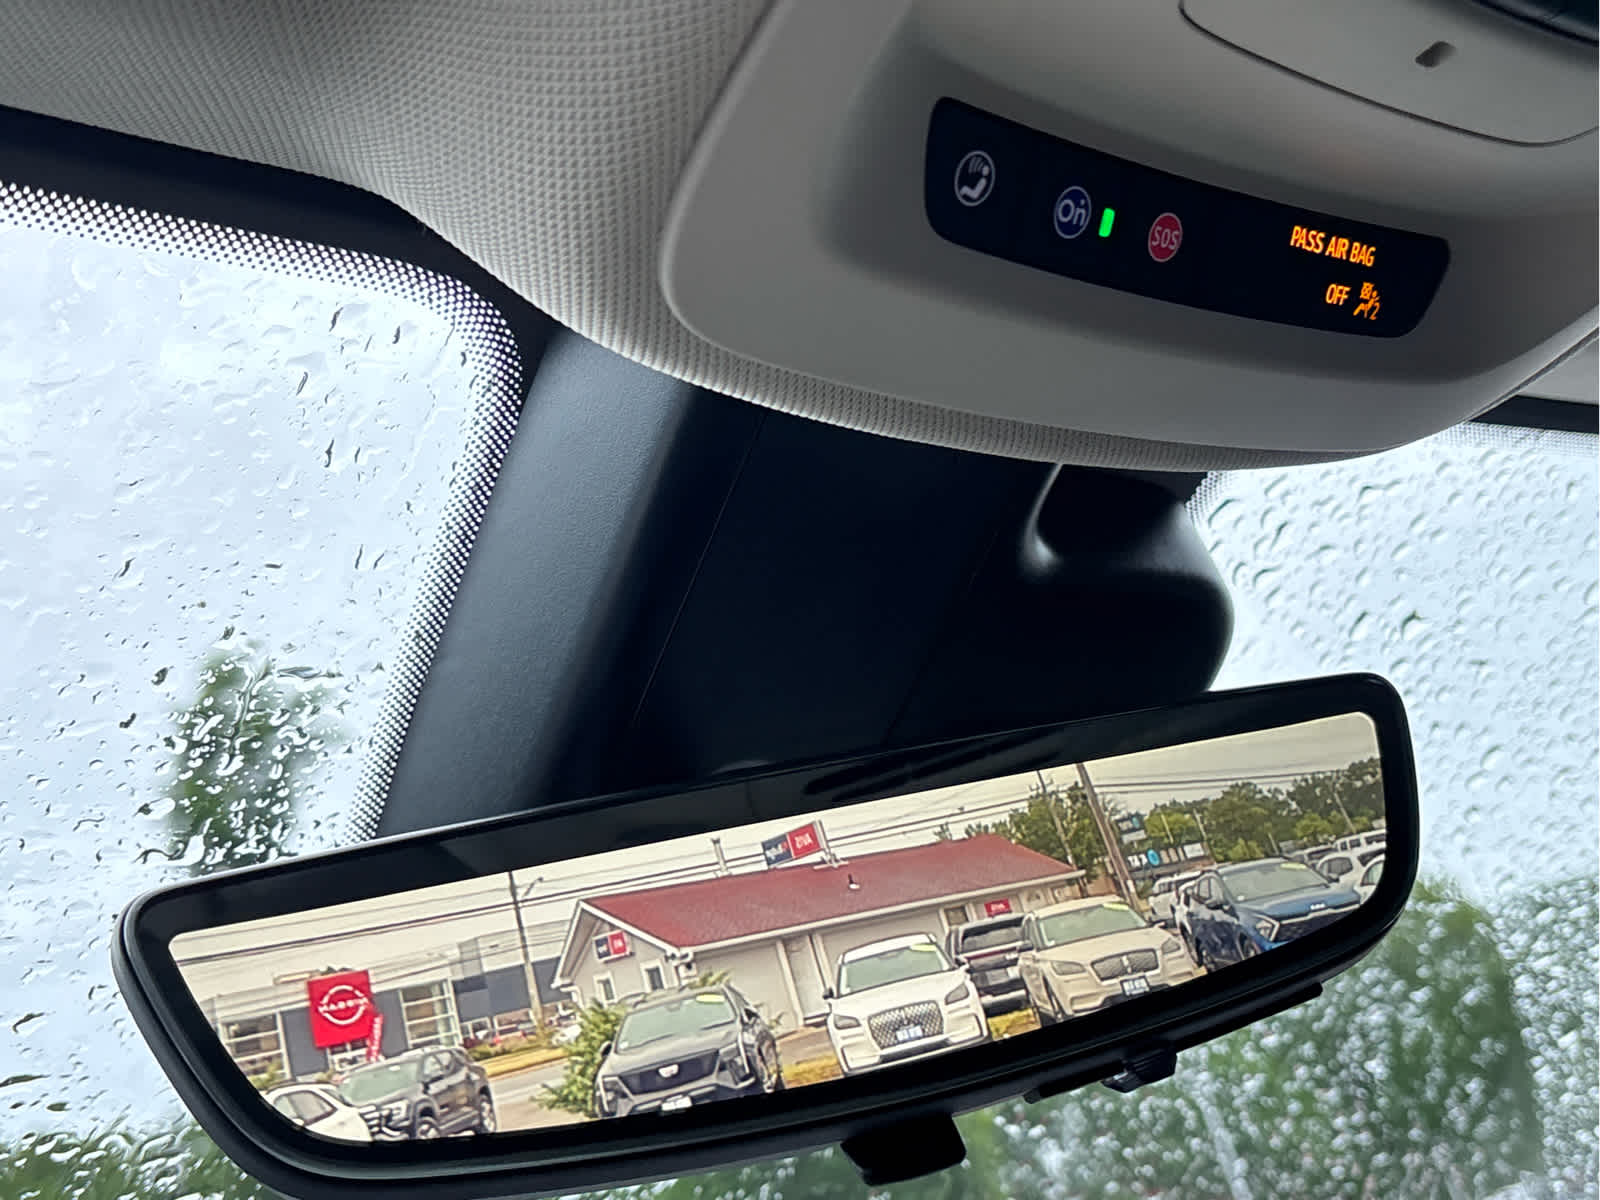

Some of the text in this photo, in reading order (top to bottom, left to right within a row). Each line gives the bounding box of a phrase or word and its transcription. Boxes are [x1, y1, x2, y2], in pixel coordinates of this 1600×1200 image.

[1151, 225, 1180, 250] SOS
[1290, 225, 1376, 267] PASS AIR BAG
[1326, 283, 1351, 305] OFF
